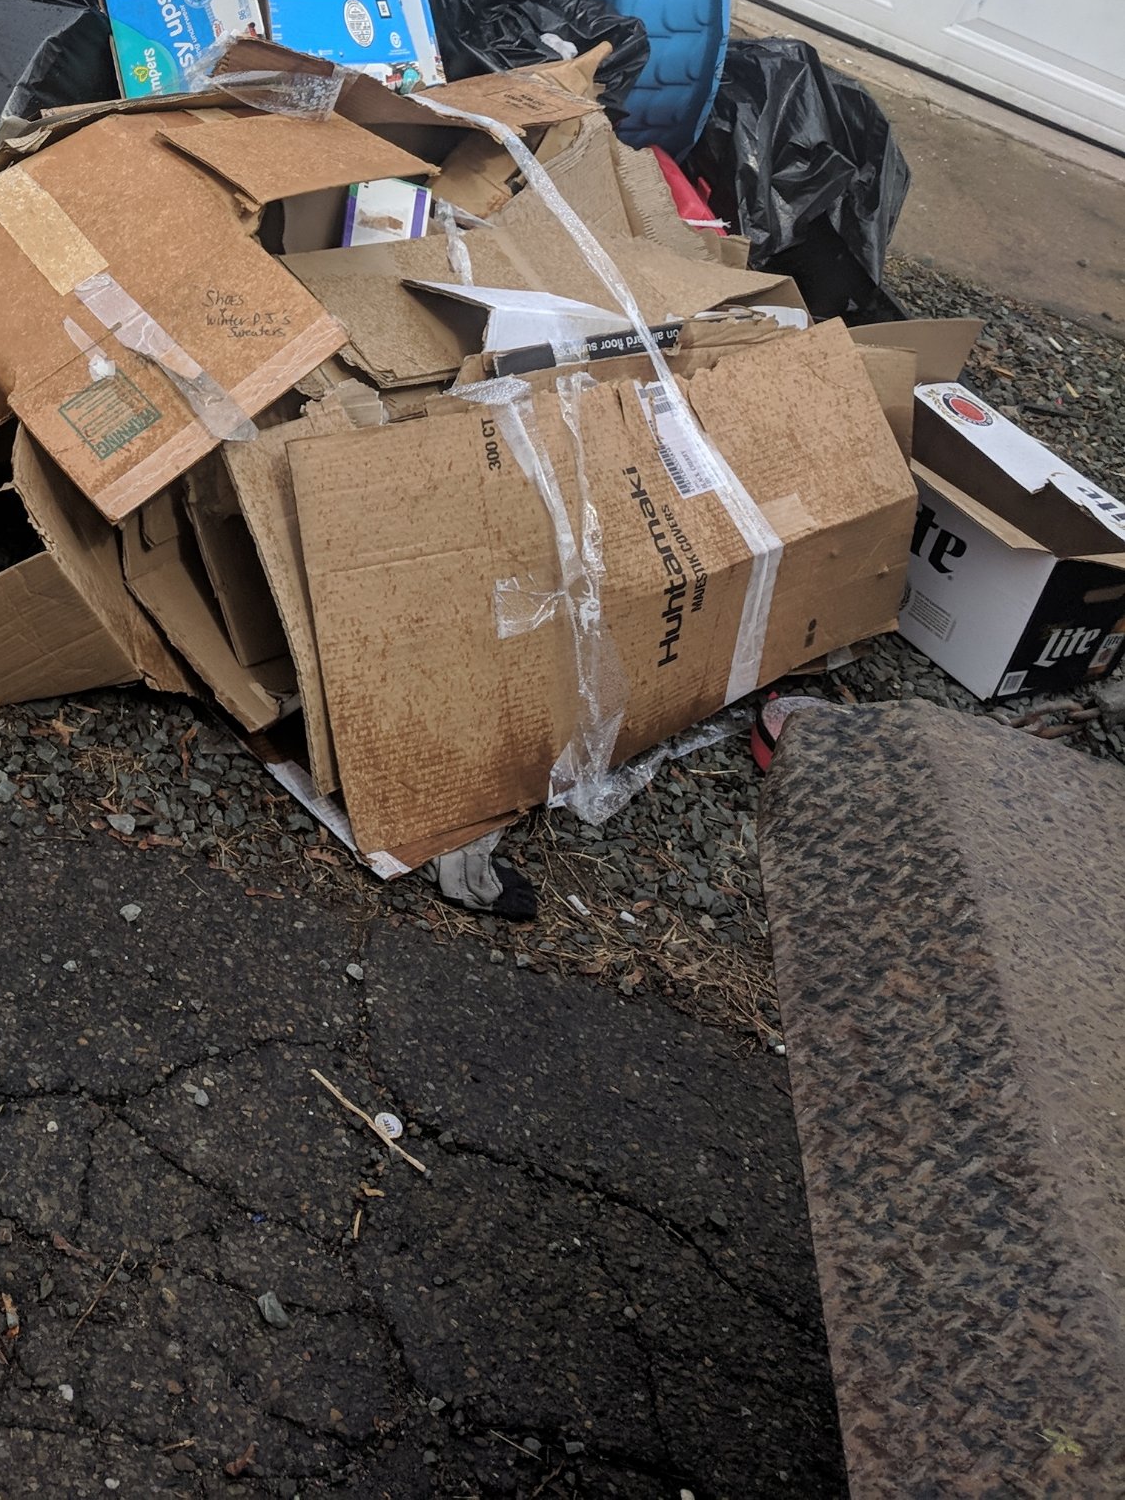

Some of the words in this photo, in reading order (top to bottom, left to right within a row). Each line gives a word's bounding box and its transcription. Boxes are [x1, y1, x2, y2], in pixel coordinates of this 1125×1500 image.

[237, 9, 247, 21] 96
[144, 46, 163, 95] mpers
[201, 289, 245, 307] Shoes
[600, 336, 625, 349] floor
[665, 328, 680, 340] on
[95, 407, 158, 456] WARNING
[481, 417, 496, 439] CT
[484, 440, 502, 471] 300
[661, 504, 689, 552] COVERS
[909, 503, 967, 574] te
[622, 466, 689, 668] Huhtamaki
[686, 549, 708, 613] MAJESTIK
[1033, 626, 1102, 668] Lite
